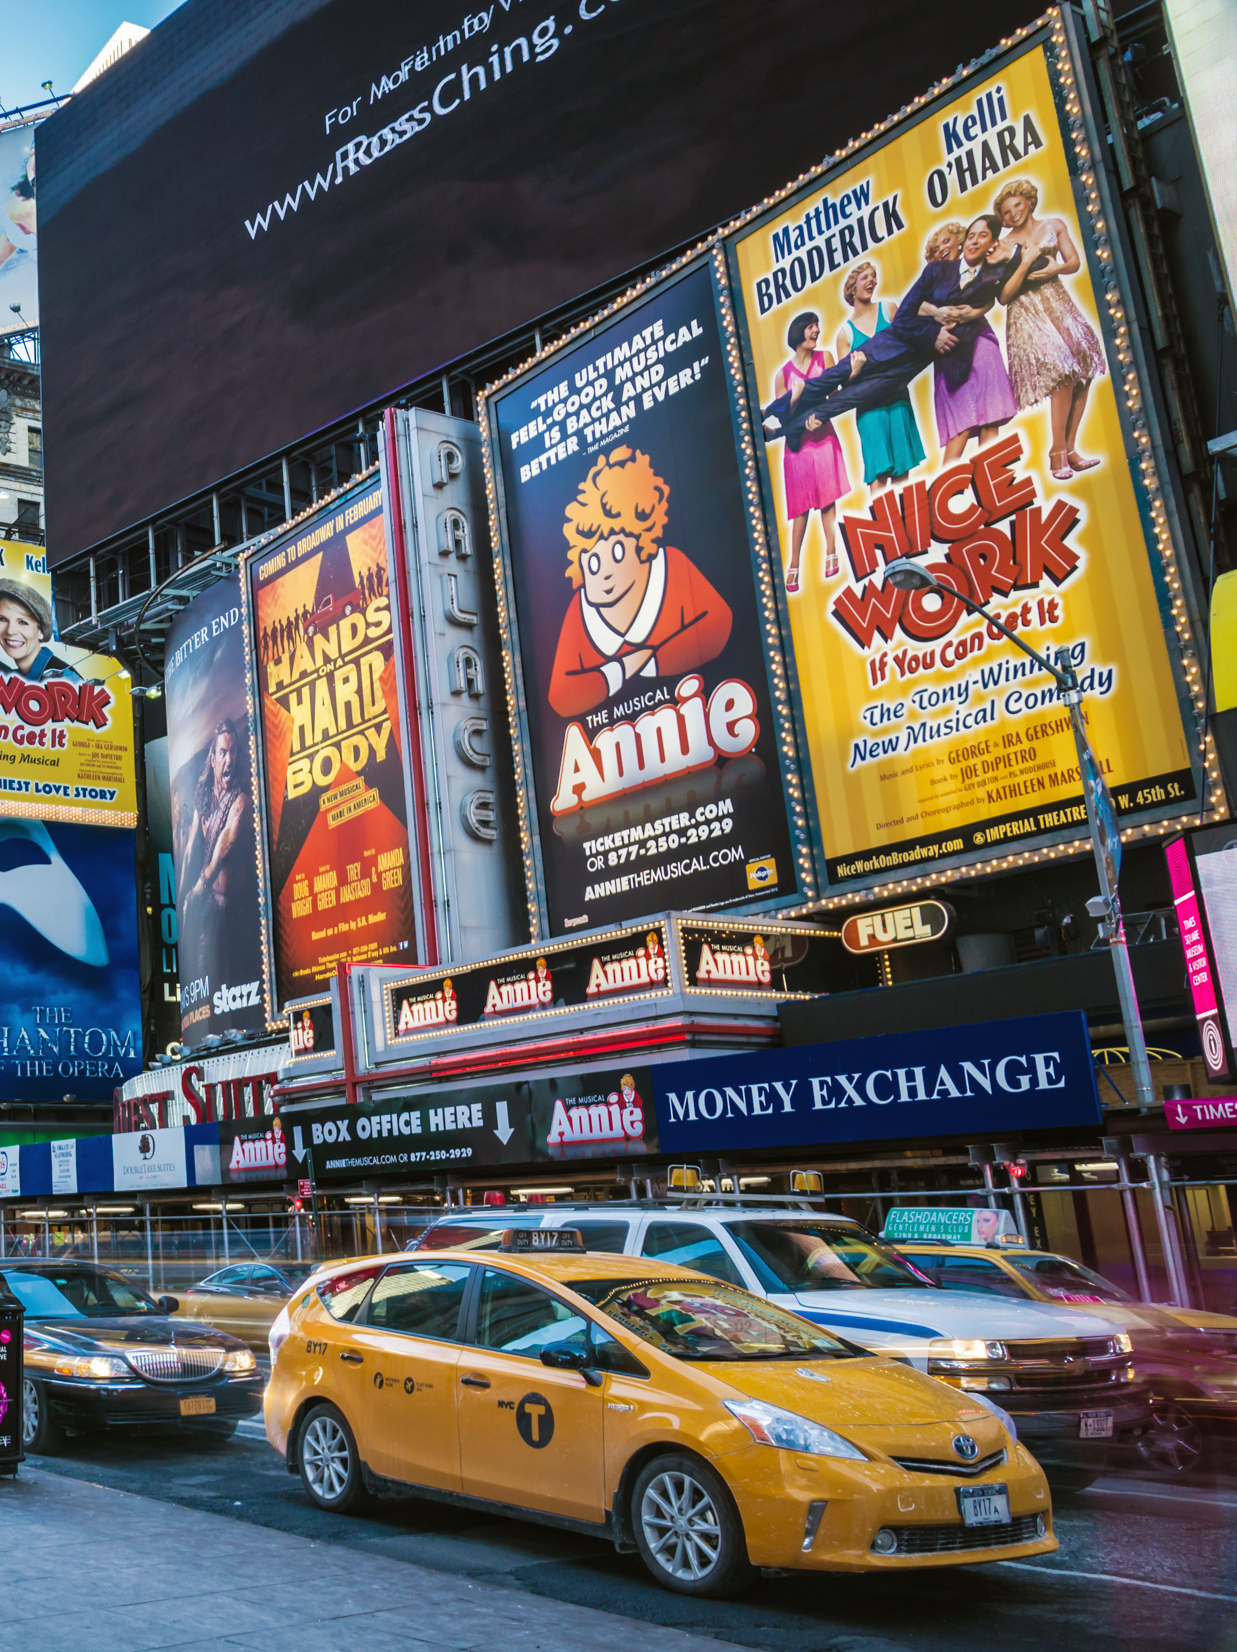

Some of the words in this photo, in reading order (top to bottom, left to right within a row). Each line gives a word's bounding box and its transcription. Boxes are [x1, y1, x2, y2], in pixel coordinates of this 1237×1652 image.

[325, 96, 362, 135] For
[942, 85, 1008, 155] Kelli
[927, 113, 1044, 209] O'HARA
[771, 179, 872, 263] Matthew
[755, 193, 905, 316] BRODERICK
[574, 318, 664, 389] ULTIMATE
[510, 379, 608, 450] FEEL-GOOD
[615, 318, 704, 386] MUSICAL
[544, 428, 561, 449] IS
[566, 391, 616, 434] BACK
[622, 363, 665, 402] AND
[519, 436, 580, 484] BETTER
[584, 401, 636, 445] THAN
[840, 432, 1038, 582] NICE
[259, 552, 287, 581] COMING
[298, 522, 335, 558] BROADWAY
[831, 498, 1082, 650] WORK
[175, 626, 209, 669] BITTER
[211, 607, 239, 637] END
[268, 596, 392, 694] HANDS
[431, 439, 498, 843] PALACE
[868, 654, 890, 686] If
[893, 648, 937, 681] You
[939, 631, 984, 669] Can
[1036, 596, 1061, 627] It
[319, 664, 334, 677] ON
[289, 650, 386, 753] HARD
[587, 712, 609, 729] THE
[613, 686, 670, 719] MUSICAL
[863, 702, 905, 729] The
[12, 725, 47, 747] Get
[51, 727, 67, 748] It
[551, 674, 760, 816] Annie
[850, 735, 901, 768] New
[904, 699, 997, 752] Musical
[947, 740, 991, 766] GEORGE
[1001, 733, 1023, 750] IRA
[19, 753, 60, 767] Musical
[286, 720, 392, 800] BODY
[960, 763, 981, 784] JOE
[34, 782, 70, 797] LOVE
[74, 785, 117, 801] STORY
[326, 791, 338, 804] NEW
[339, 782, 362, 800] MUSICAL
[331, 808, 345, 823] MADE
[353, 793, 377, 812] AMERICA
[986, 776, 1046, 805] KATHLEEN
[583, 798, 734, 856] TICKETMASTER.COM
[587, 857, 605, 872] OR
[607, 818, 733, 867] 877-250-2929
[836, 838, 964, 879] NiceWorkOnBroadway.com
[985, 817, 1037, 843] IMPERIAL
[1037, 803, 1088, 828] THEATRE
[1136, 786, 1165, 807] 45th
[584, 845, 745, 901] ANNIETHEMUSICAL.COM
[749, 868, 774, 880] Pedigree
[857, 906, 932, 947] FUEL
[1183, 916, 1196, 931] TIMES
[1184, 929, 1200, 946] SQUARE
[586, 947, 666, 996] Annie
[696, 945, 772, 985] Annie
[1186, 943, 1204, 959] MUSEUM
[1192, 957, 1207, 972] VISITOR
[213, 980, 261, 1015] starz
[484, 970, 553, 1015] Annie
[1192, 973, 1208, 987] CENTER
[32, 1006, 72, 1024] THE
[189, 1004, 211, 1023] PLACES
[398, 990, 458, 1033] Annie
[12, 1059, 54, 1078] THE
[58, 1060, 125, 1078] OPERA
[666, 1080, 798, 1122] MONEY
[808, 1051, 1066, 1110] EXCHANGE
[312, 1120, 351, 1145] BOX
[356, 1111, 422, 1139] OFFICE
[428, 1103, 484, 1132] HERE
[547, 1091, 645, 1147] Annie
[230, 1131, 287, 1170] Annie
[888, 1224, 944, 1233] GENTLEMEN'S
[946, 1225, 969, 1233] CLUB
[890, 1210, 972, 1224] FLASHDANCERS
[532, 1232, 558, 1246] 8Y17
[306, 1340, 328, 1356] 8Y17
[498, 1401, 515, 1410] NYC
[525, 1403, 545, 1442] T
